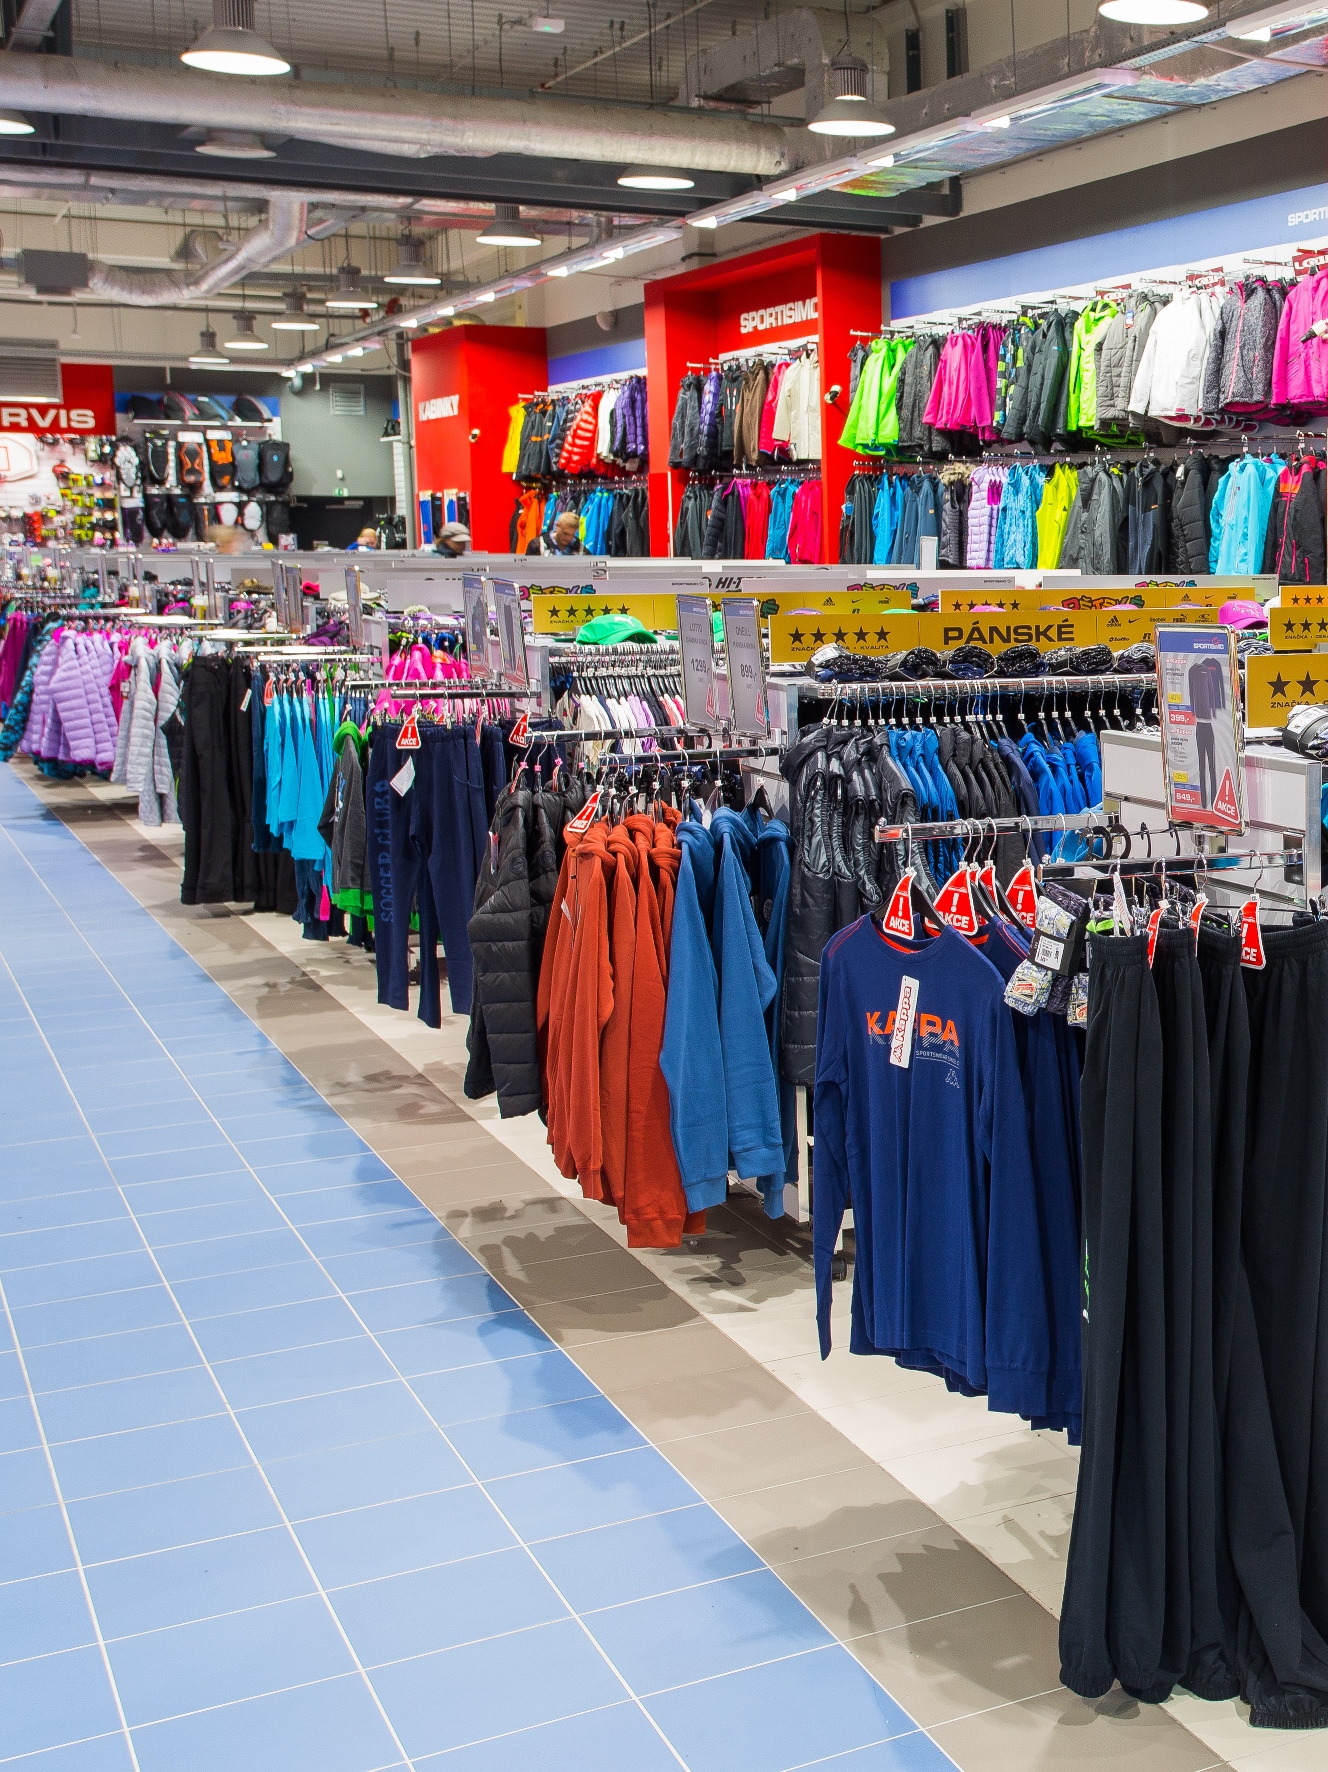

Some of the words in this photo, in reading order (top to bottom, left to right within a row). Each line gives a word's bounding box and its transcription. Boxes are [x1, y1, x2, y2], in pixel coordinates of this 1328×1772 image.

[419, 394, 459, 421] KABINKY
[1, 407, 95, 429] RVIS
[943, 617, 1075, 646] PÁNSKÉ
[1193, 642, 1225, 650] SPORTISIMO
[1270, 699, 1310, 709] ZNAČKA
[1169, 713, 1190, 724] 399,-
[401, 737, 418, 746] AKCE
[1217, 800, 1236, 816] AKCE
[889, 915, 910, 933] AKCE
[938, 910, 969, 929] AKCE
[1243, 946, 1258, 962] CE
[895, 985, 912, 1043] Kappa
[866, 1011, 960, 1047] KAPA
